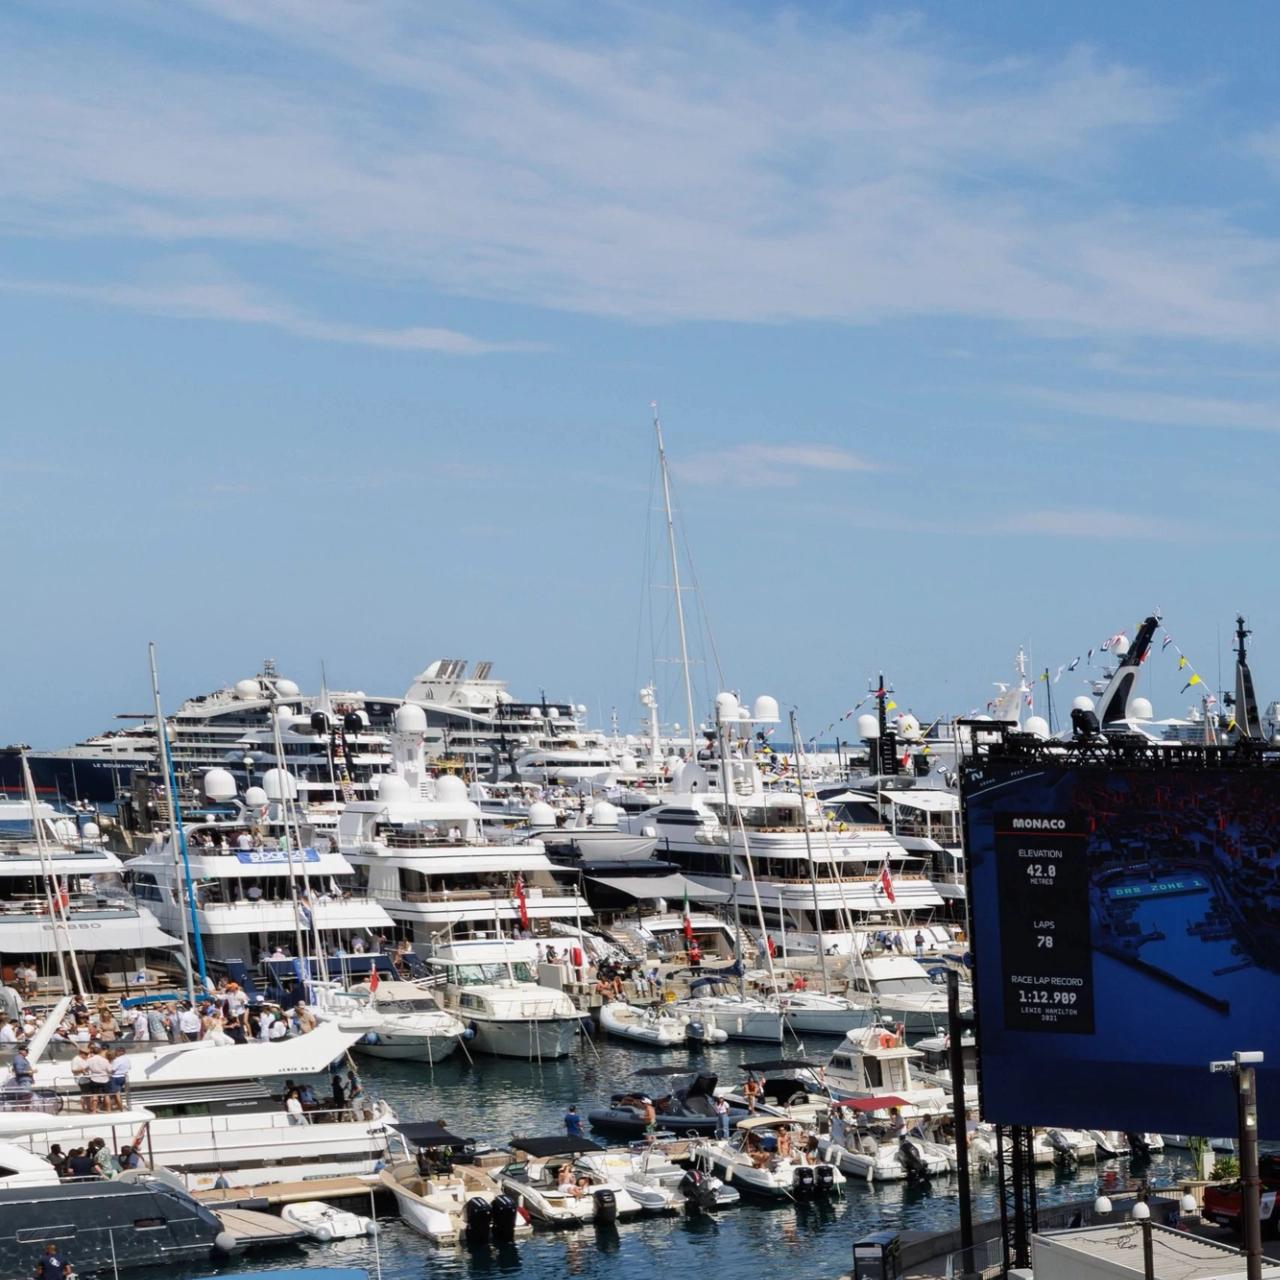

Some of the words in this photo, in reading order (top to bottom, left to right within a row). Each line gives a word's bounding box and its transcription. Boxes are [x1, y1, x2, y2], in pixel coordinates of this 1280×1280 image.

[1012, 818, 1066, 829] MONACO
[1018, 849, 1063, 858] ELEVATION
[1026, 864, 1057, 877] 42.0
[1033, 920, 1056, 929] LAPS
[1037, 935, 1054, 948] 78
[1011, 975, 1033, 984] RACE
[1033, 976, 1050, 985] LAP
[1051, 977, 1083, 986] RECORD
[1019, 990, 1078, 1004] 1:12.909
